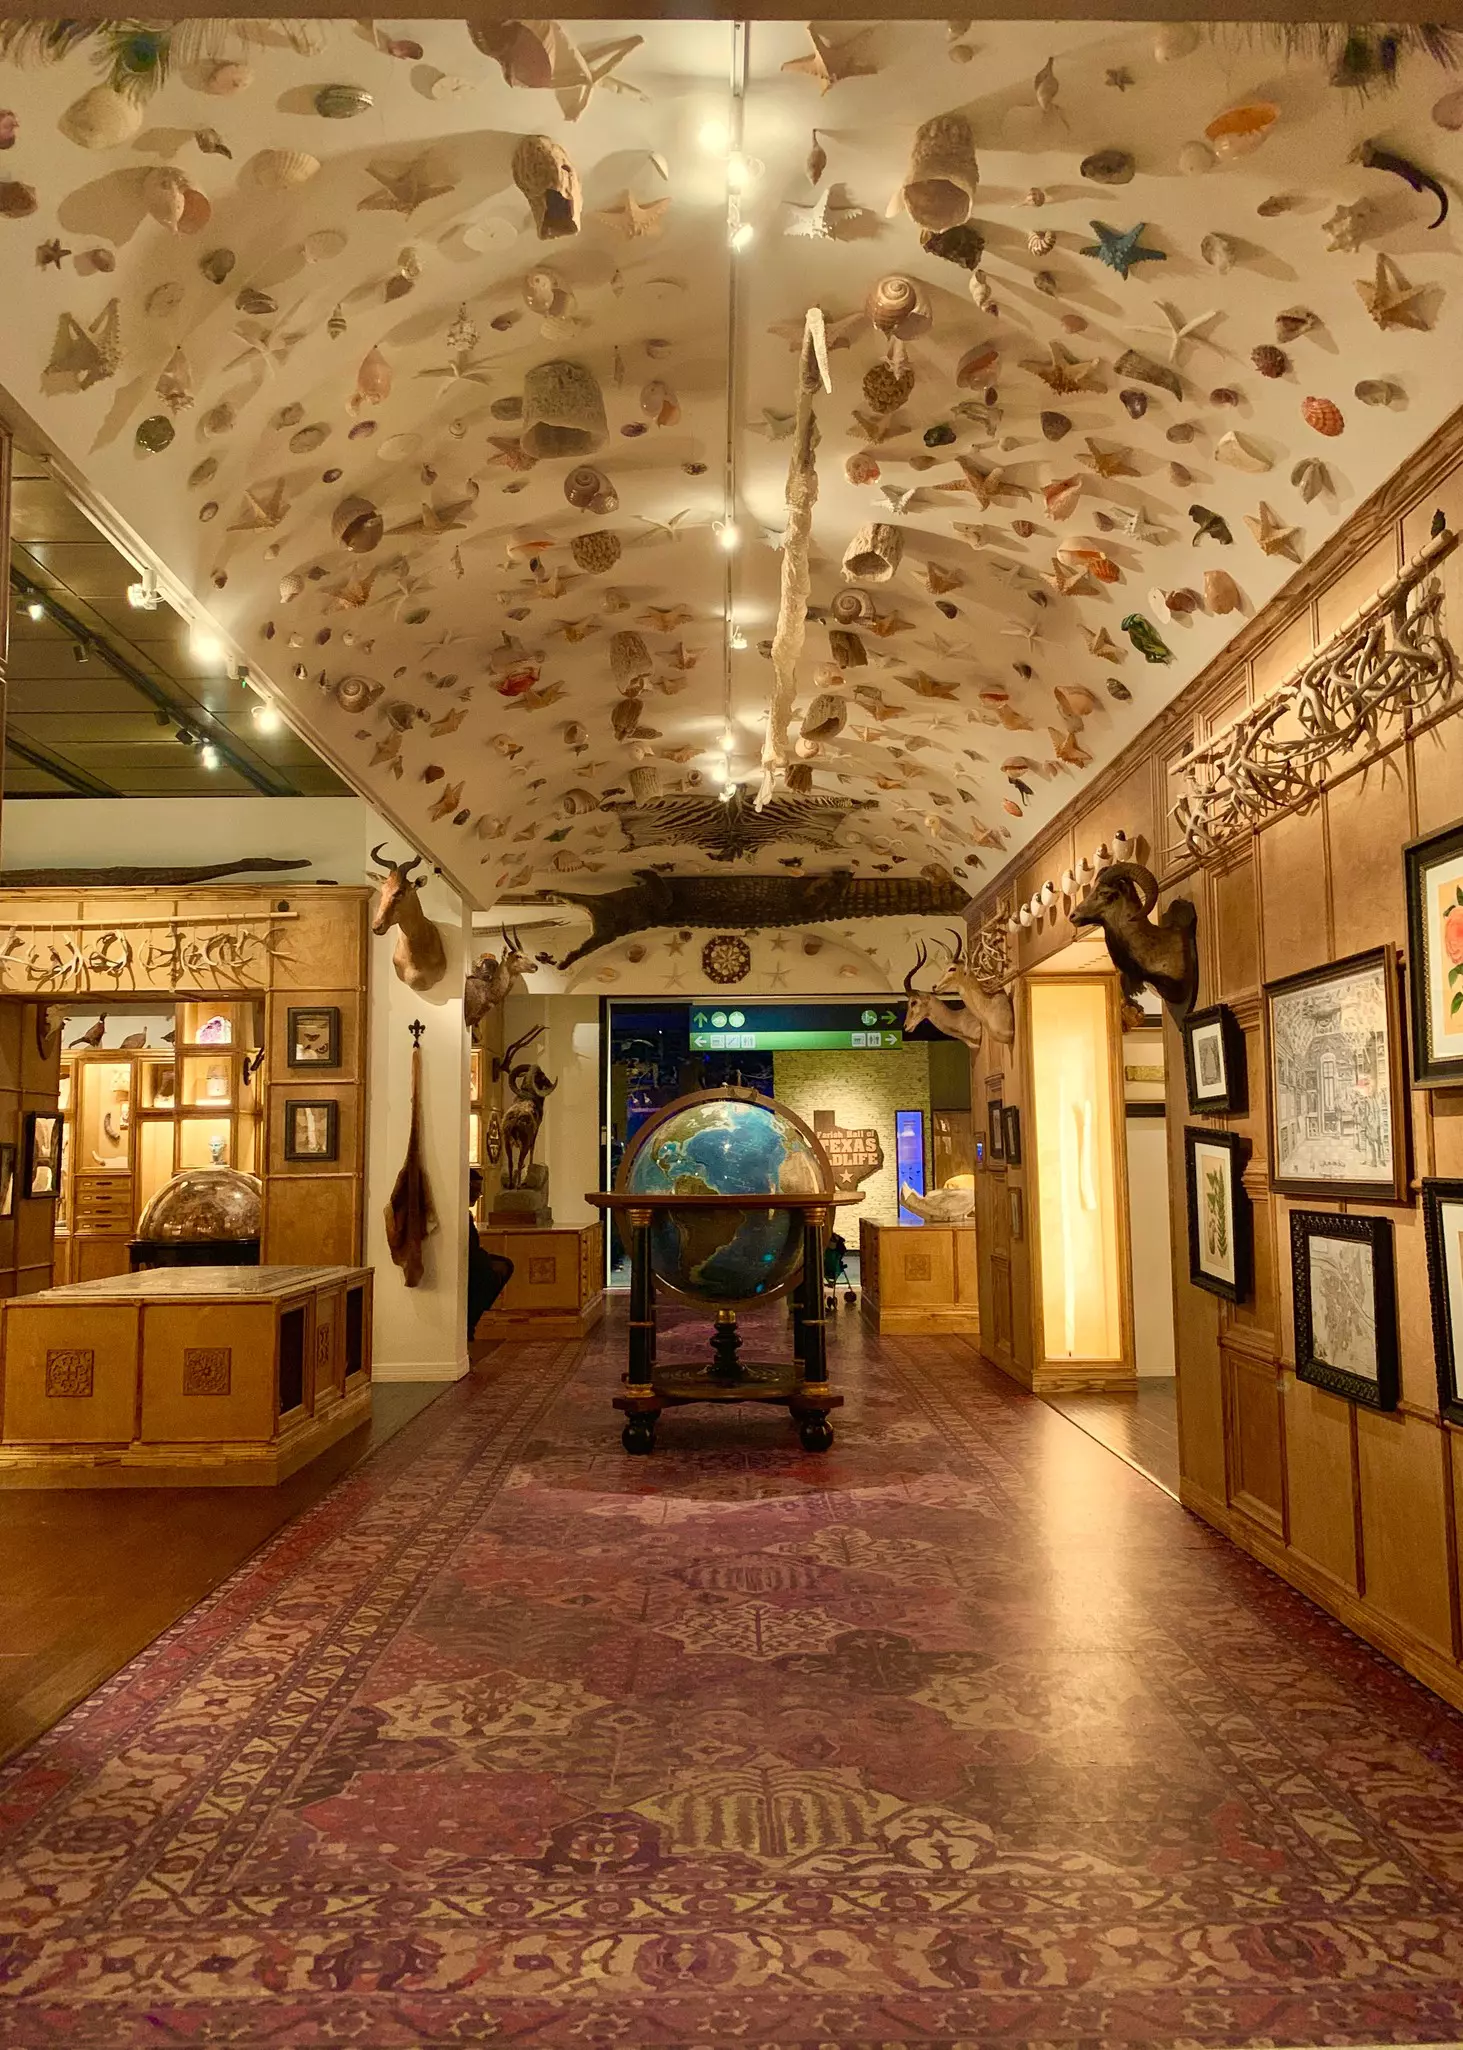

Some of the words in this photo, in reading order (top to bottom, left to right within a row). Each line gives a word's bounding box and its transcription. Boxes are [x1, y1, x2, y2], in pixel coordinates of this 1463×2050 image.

[846, 1130, 864, 1138] Hall
[819, 1138, 877, 1153] TEXAS
[829, 1153, 879, 1166] DLIFE
